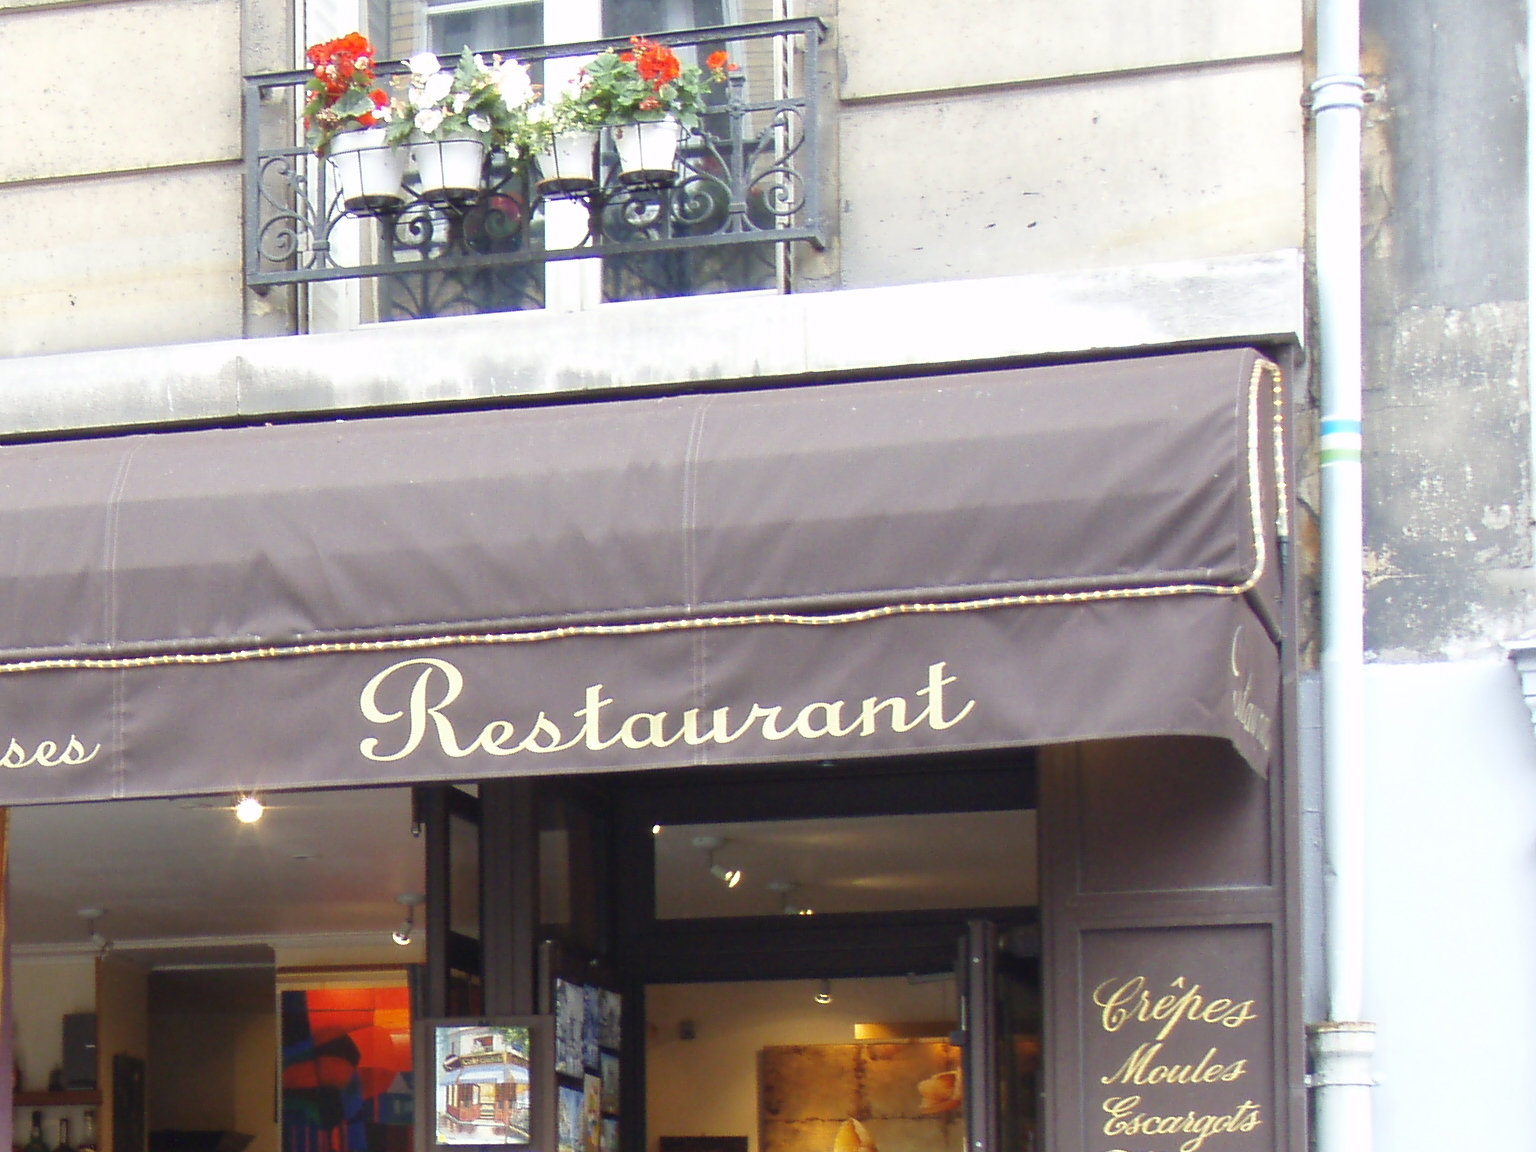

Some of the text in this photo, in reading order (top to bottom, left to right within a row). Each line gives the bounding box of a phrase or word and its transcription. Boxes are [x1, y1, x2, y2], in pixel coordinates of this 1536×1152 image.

[358, 657, 977, 762] Restaurant
[1093, 976, 1258, 1041] Crêpes
[1100, 1042, 1249, 1086] Moules
[1102, 1095, 1263, 1152] Escargots
